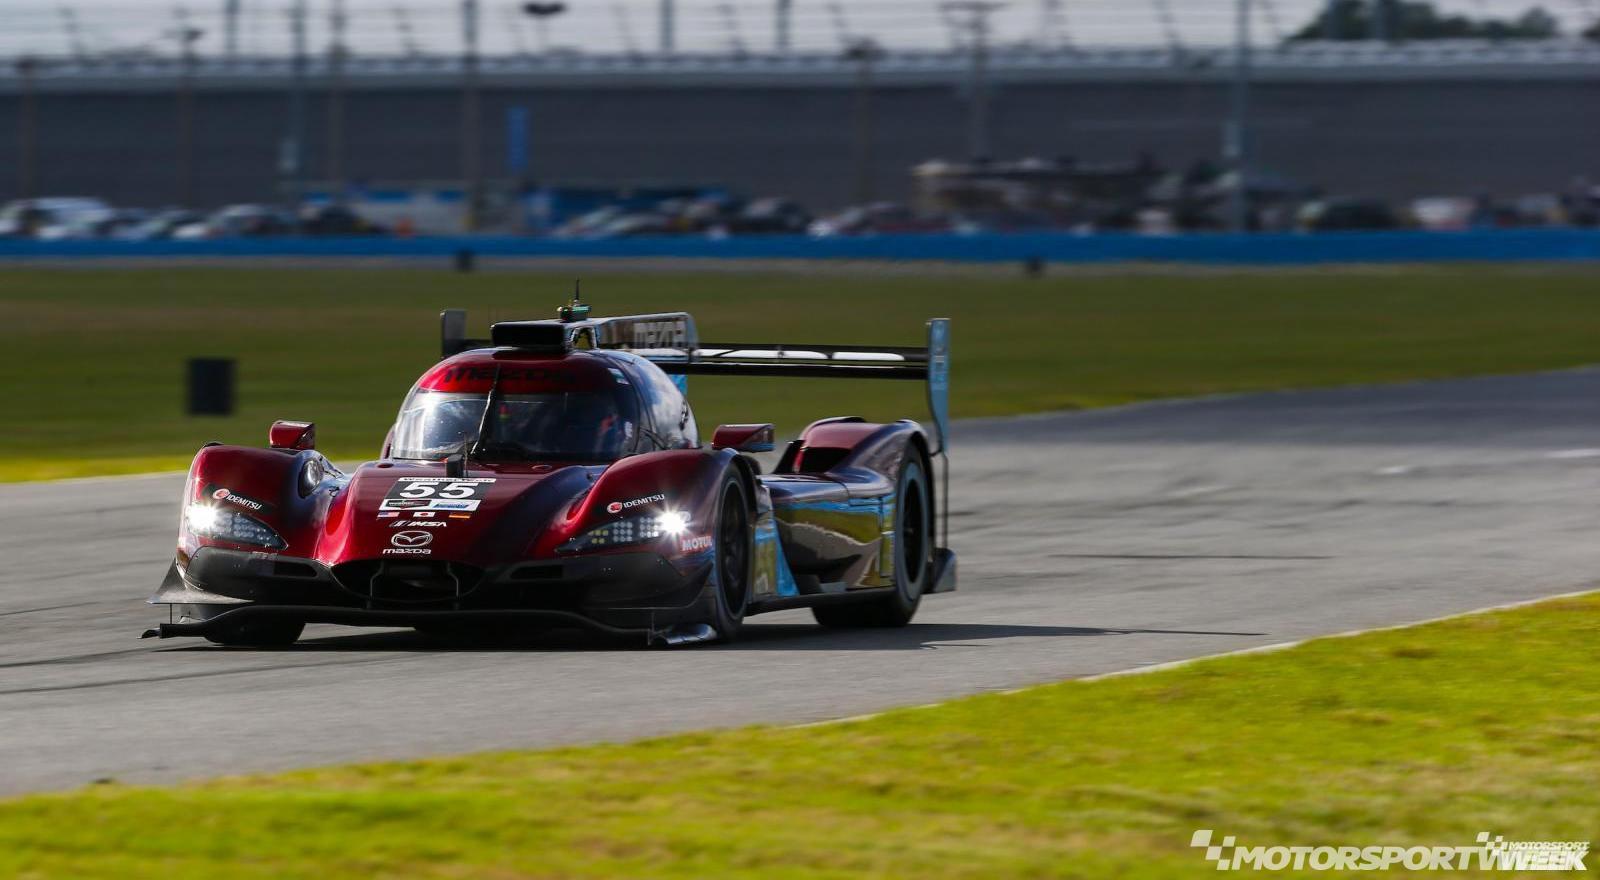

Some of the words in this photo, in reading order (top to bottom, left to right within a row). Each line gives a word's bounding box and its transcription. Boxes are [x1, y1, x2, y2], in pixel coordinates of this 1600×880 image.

[399, 481, 480, 499] 55
[225, 493, 263, 510] IDEMITSU
[623, 493, 665, 509] IDEMITSU
[681, 535, 713, 552] MOTUL
